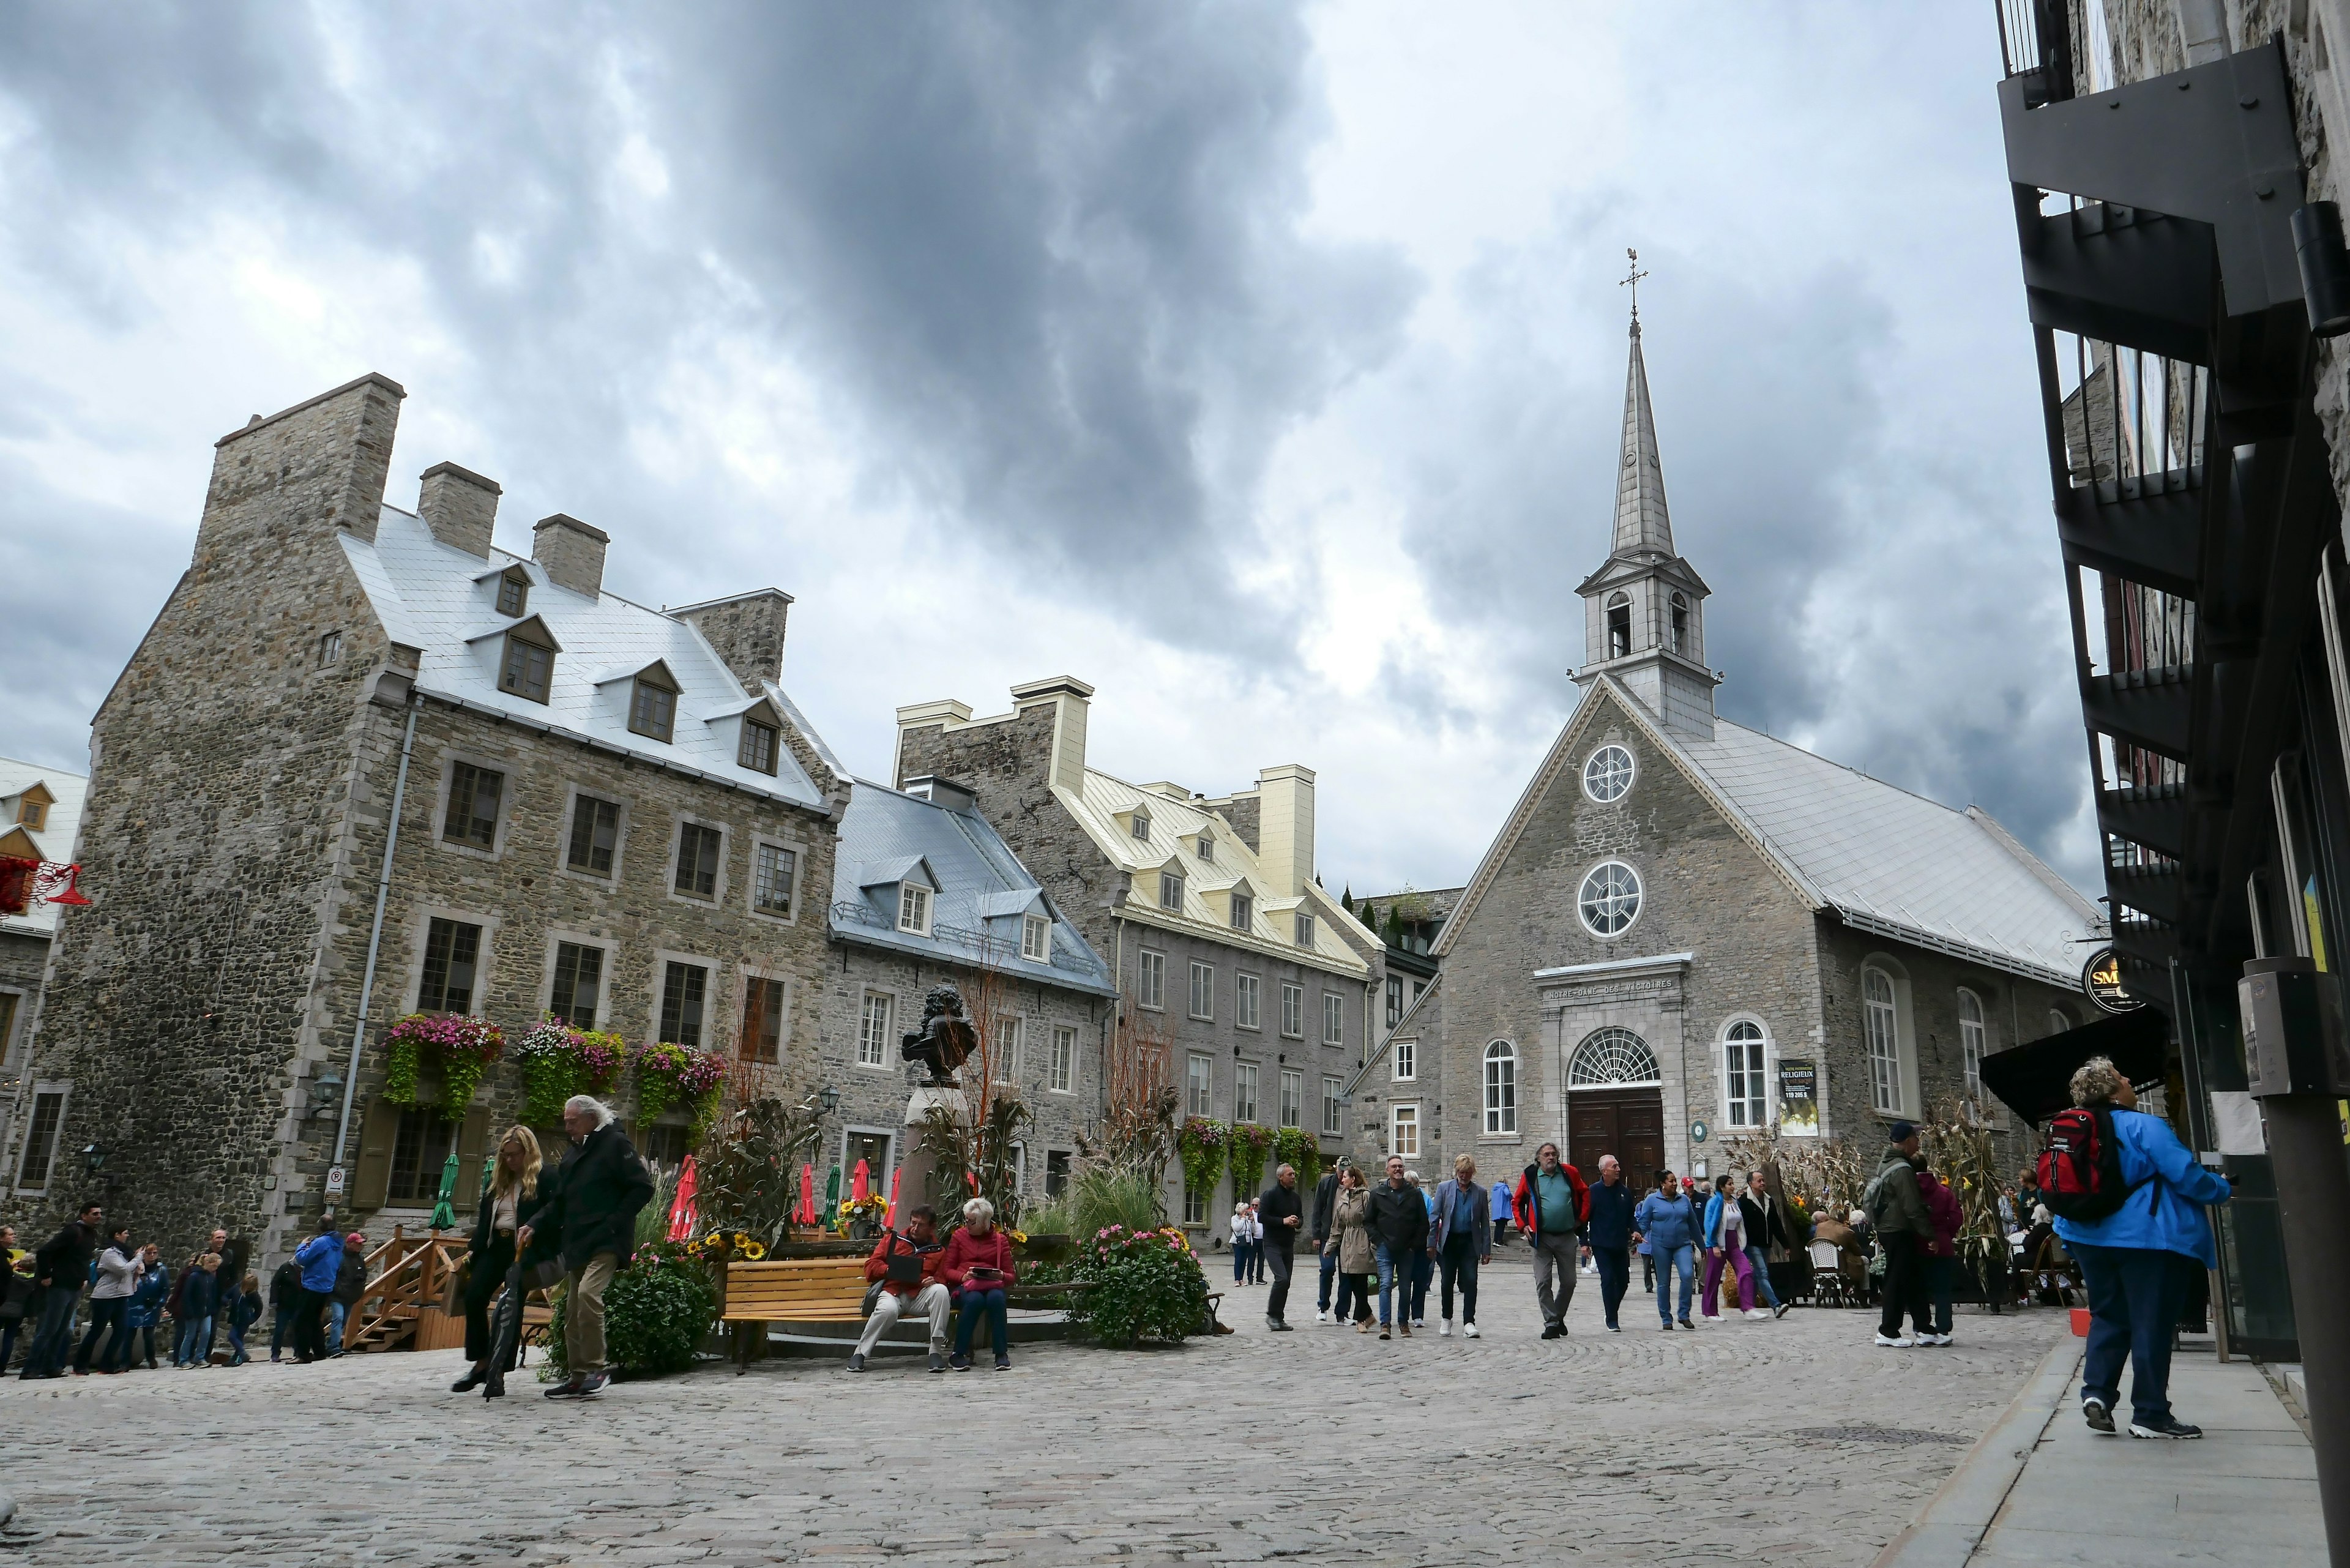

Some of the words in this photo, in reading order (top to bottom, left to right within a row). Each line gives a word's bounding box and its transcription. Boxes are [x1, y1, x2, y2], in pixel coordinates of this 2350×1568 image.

[1550, 988, 1597, 999] NOTRE-DAME
[1604, 985, 1619, 994] DES
[1626, 980, 1672, 991] VICTOIRES
